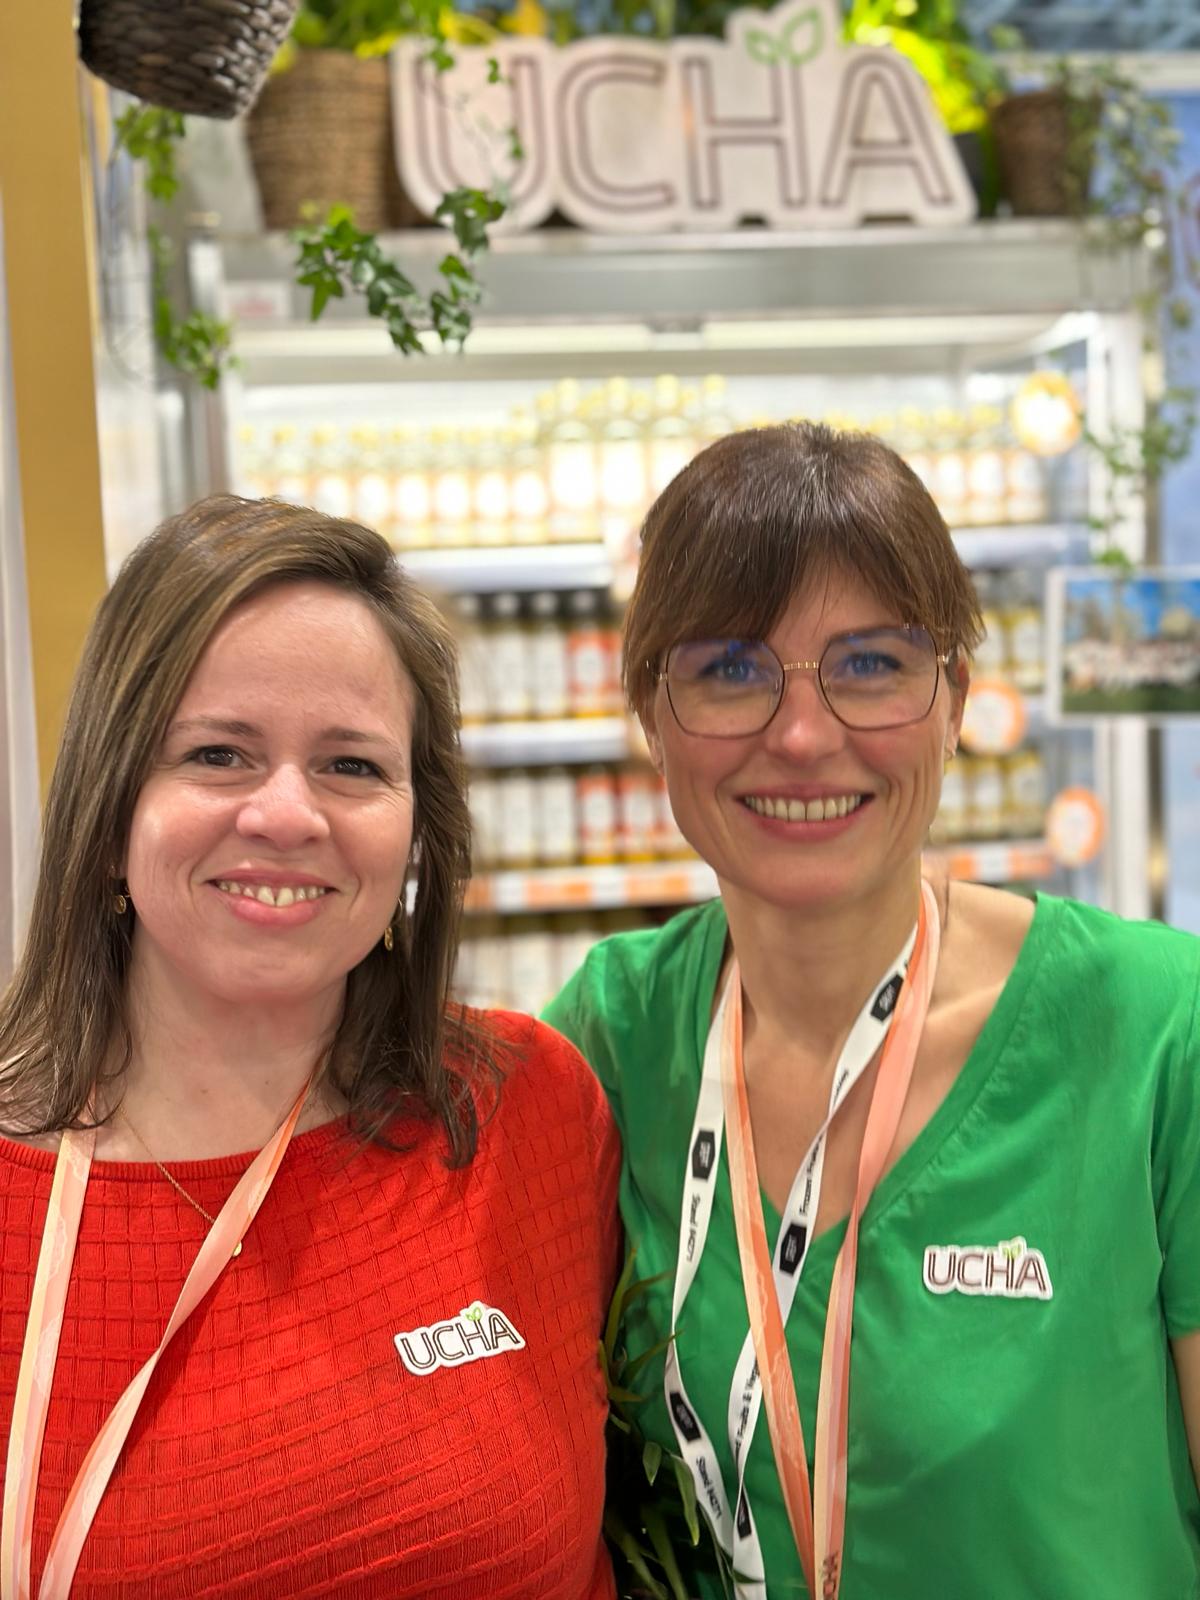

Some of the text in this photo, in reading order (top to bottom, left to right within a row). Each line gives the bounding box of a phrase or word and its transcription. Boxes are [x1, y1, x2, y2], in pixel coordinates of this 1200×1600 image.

[413, 49, 954, 212] UCHA
[927, 1251, 1047, 1292] UCHA
[399, 1312, 521, 1370] UCHA
